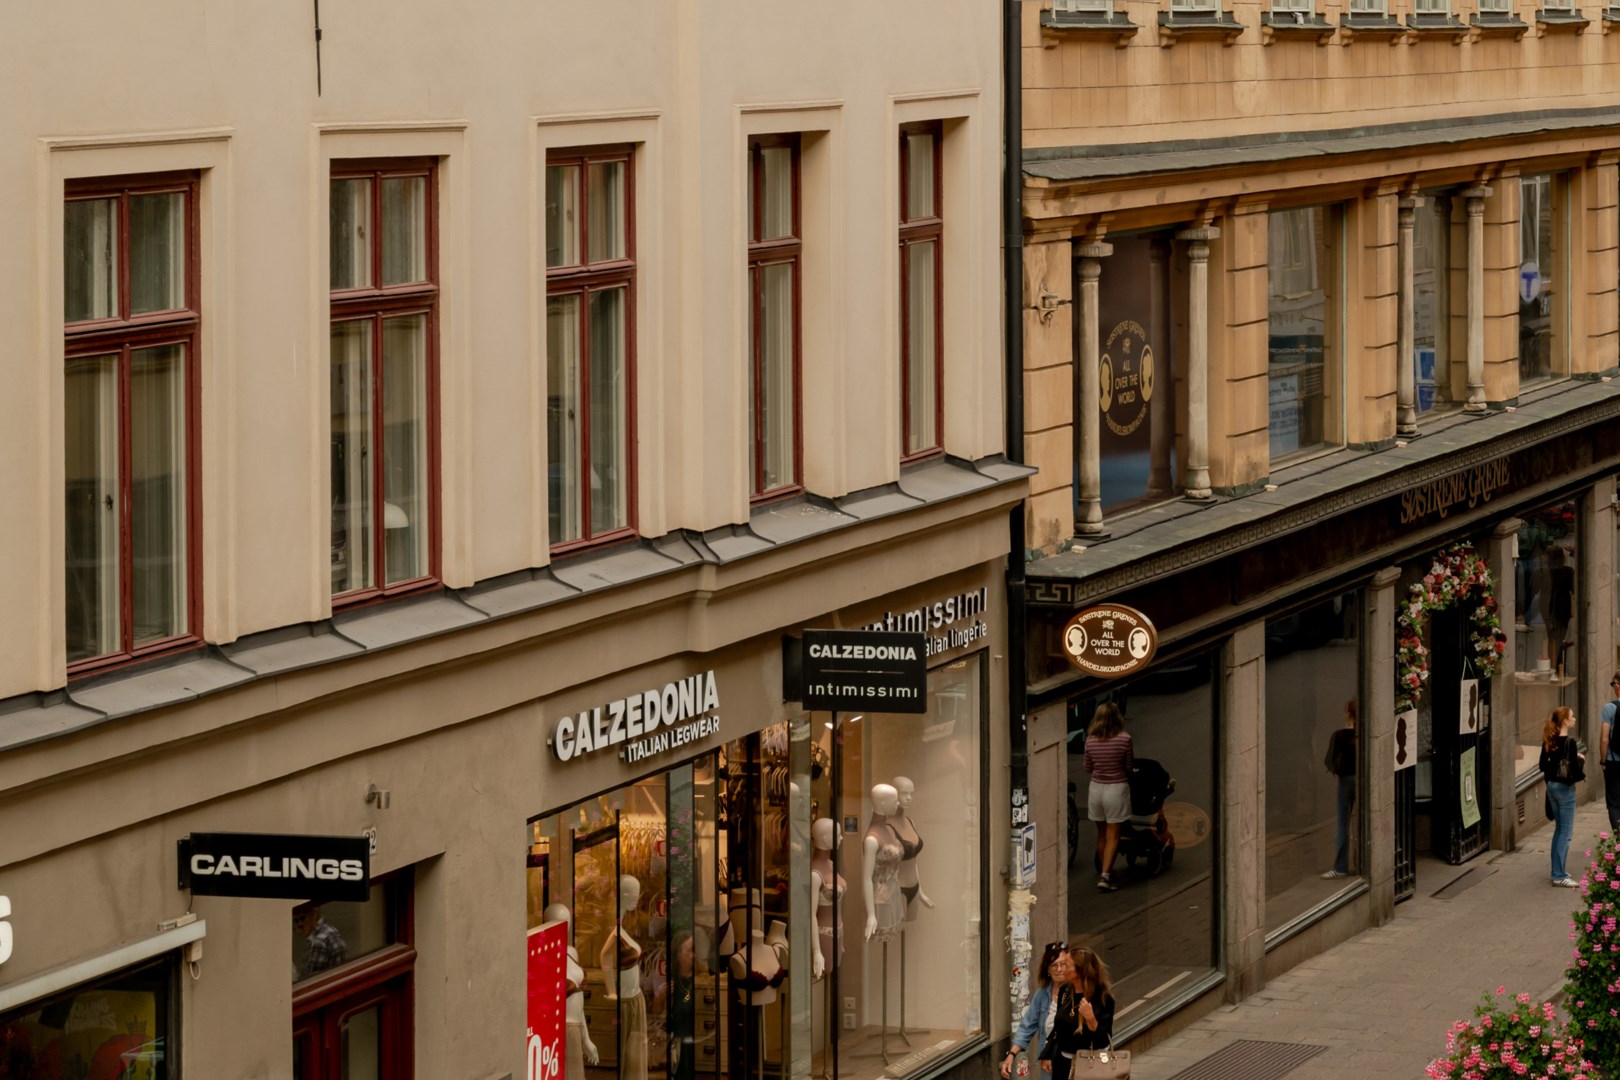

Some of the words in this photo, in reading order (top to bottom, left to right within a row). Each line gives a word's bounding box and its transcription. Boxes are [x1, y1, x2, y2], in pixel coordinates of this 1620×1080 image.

[1122, 360, 1131, 372] ALL
[1115, 376, 1128, 390] OVER
[1129, 374, 1138, 387] THE
[1117, 391, 1136, 405] WORLD
[1401, 469, 1467, 524] SØSTRENE
[1112, 611, 1138, 626] GRENES
[950, 620, 987, 649] lingerie
[1102, 631, 1114, 639] ALL
[1090, 639, 1110, 647] OVER
[1112, 640, 1125, 648] THE
[809, 644, 917, 661] CALZEDONIA
[1094, 647, 1121, 656] WORLD
[808, 683, 918, 698] intimissimi
[555, 670, 720, 762] CALZEDONIA
[627, 731, 670, 763] ITALIAN
[670, 715, 720, 748] LEGWEAR
[190, 853, 364, 881] CARLINGS
